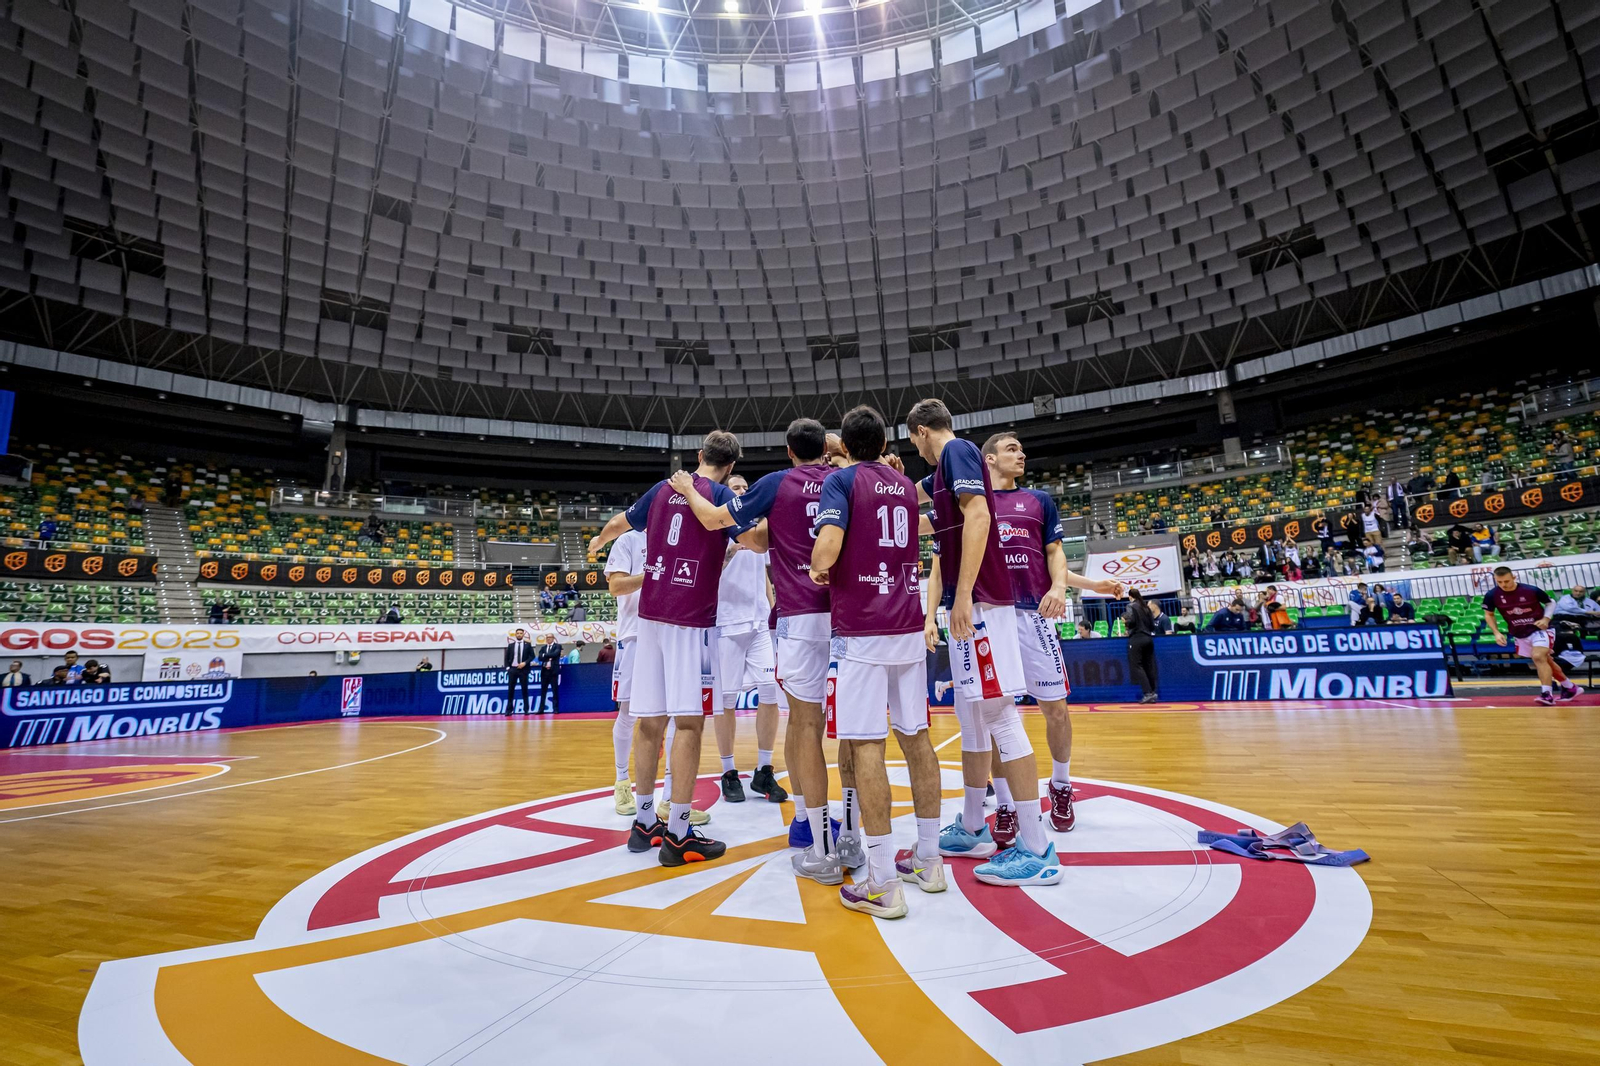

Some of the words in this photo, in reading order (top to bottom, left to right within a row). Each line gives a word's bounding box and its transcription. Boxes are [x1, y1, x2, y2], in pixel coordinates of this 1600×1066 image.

[802, 481, 823, 494] Mu
[874, 481, 905, 496] Grela
[667, 513, 683, 546] 8
[877, 505, 909, 548] 10
[117, 629, 240, 649] 2025
[277, 631, 351, 645] COPA
[357, 627, 455, 643] ESPAÑA
[1035, 625, 1051, 656] llevamos?
[1205, 635, 1298, 656] SANTIAGO
[1302, 634, 1330, 653] DE
[1047, 634, 1062, 674] MADRID
[443, 673, 482, 686] SANTIAGO
[485, 671, 497, 684] DE
[16, 688, 104, 707] SANTIAGO
[108, 687, 130, 702] DE
[133, 683, 224, 701] COMPOSTELA
[66, 707, 224, 742] MONBUS
